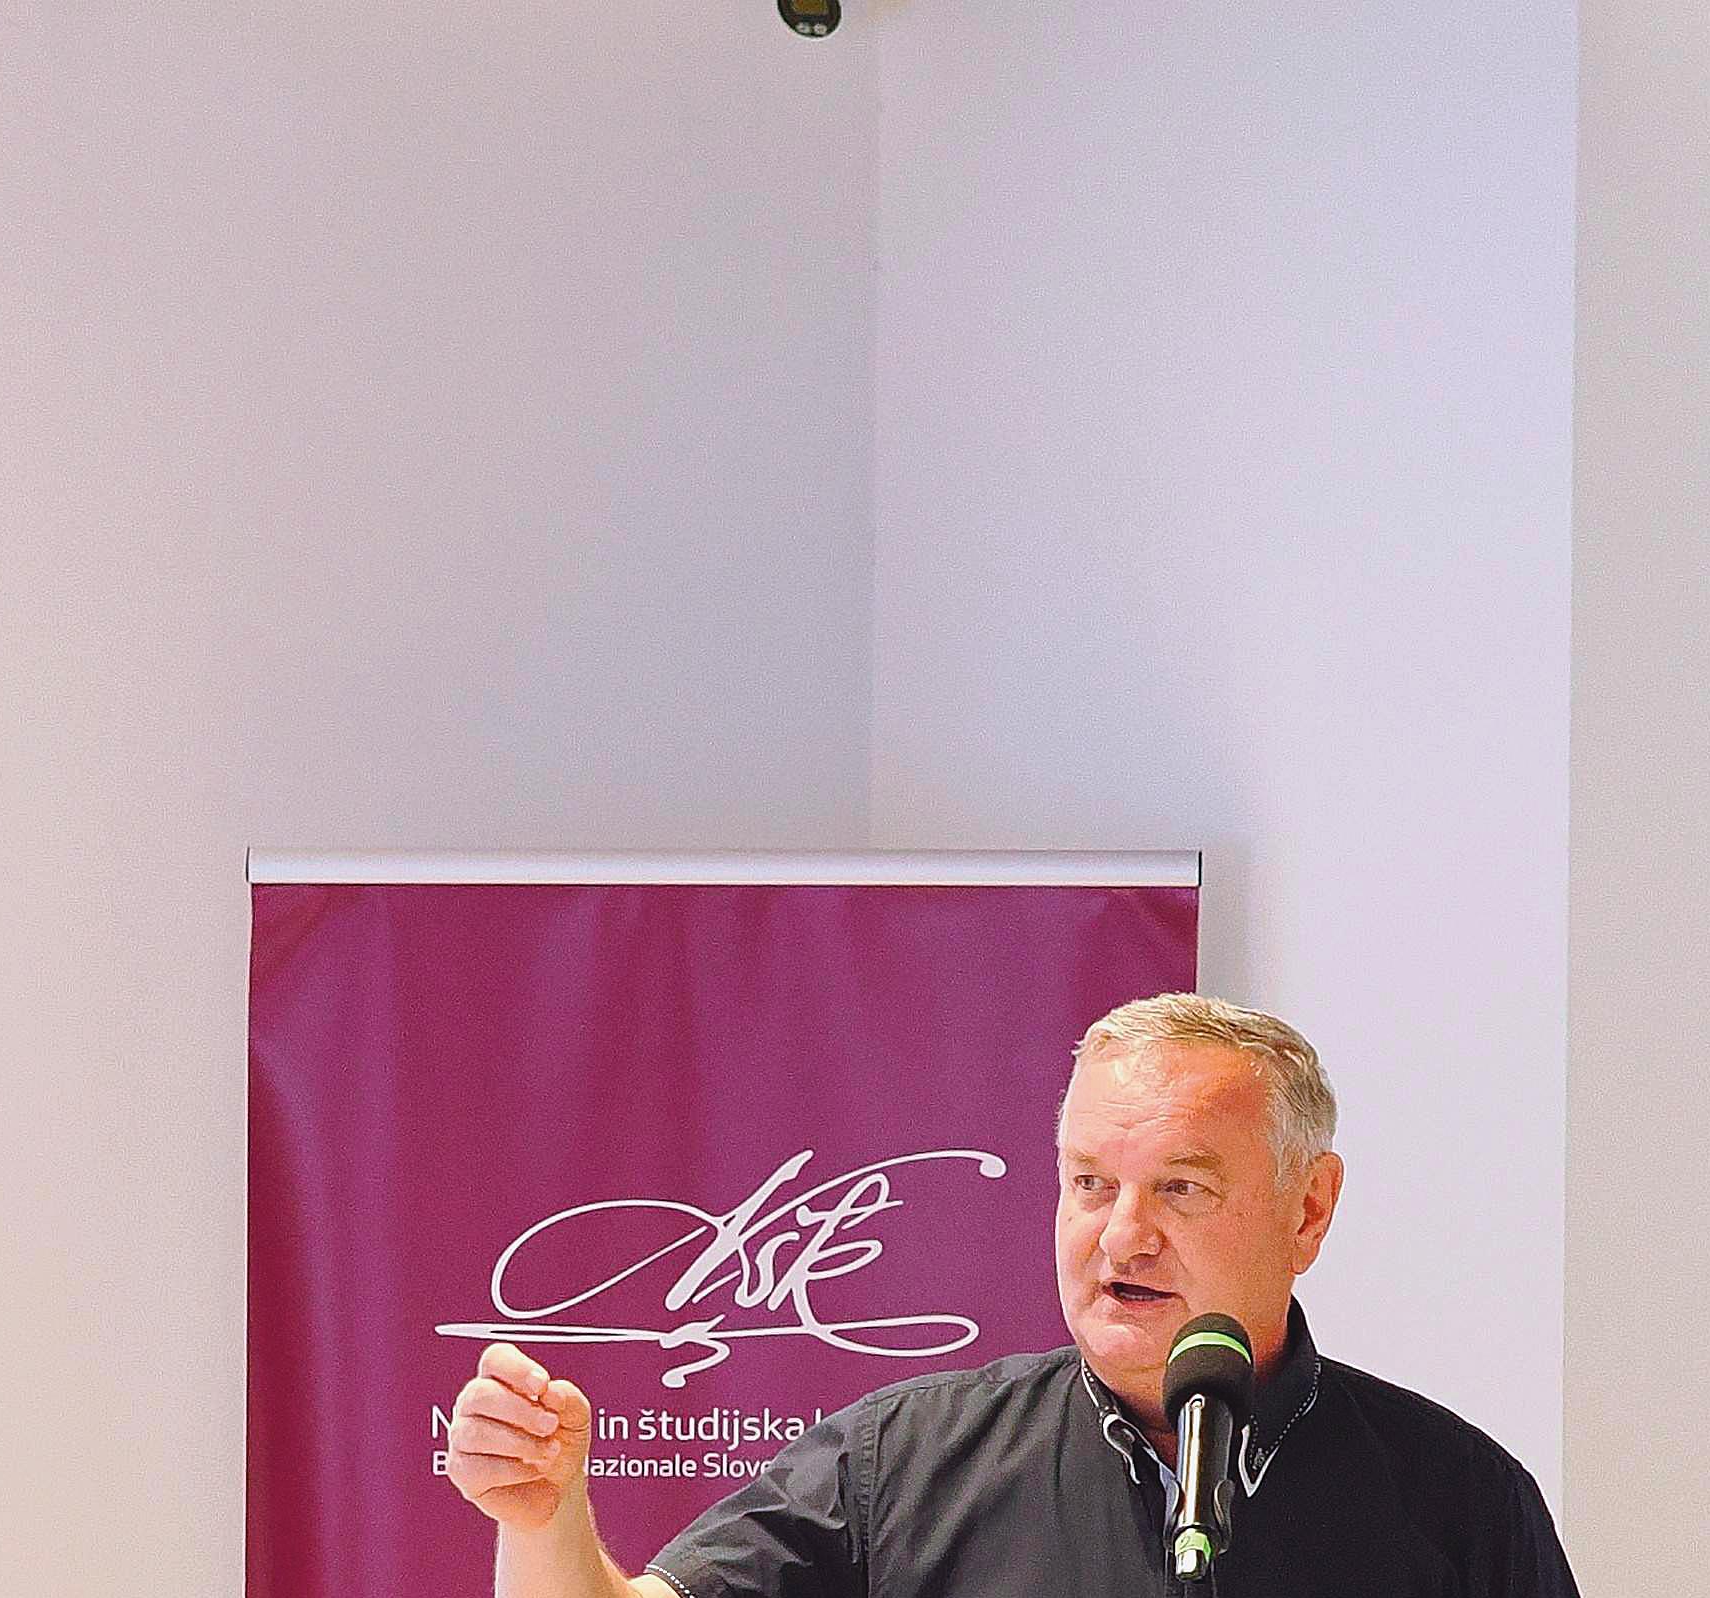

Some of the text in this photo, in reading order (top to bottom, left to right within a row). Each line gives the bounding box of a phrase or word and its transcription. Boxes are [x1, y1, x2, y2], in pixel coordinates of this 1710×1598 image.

[598, 1408, 629, 1440] in
[638, 1407, 805, 1451] študijska
[585, 1453, 697, 1477] azionale
